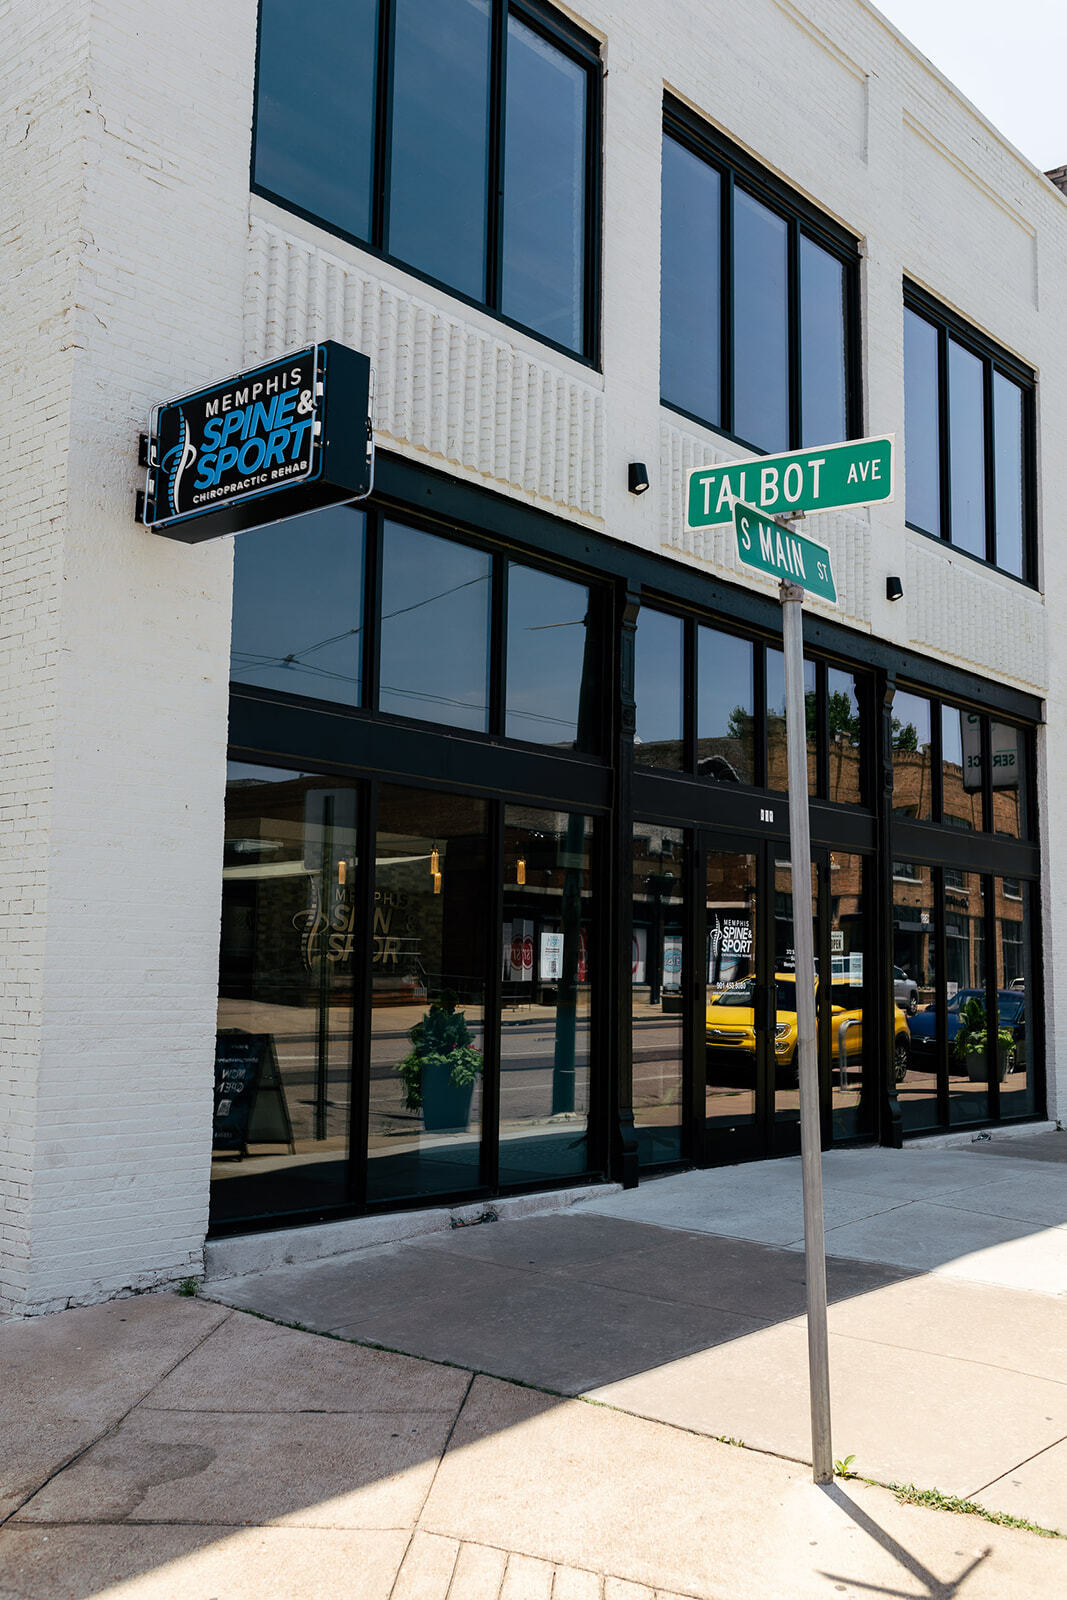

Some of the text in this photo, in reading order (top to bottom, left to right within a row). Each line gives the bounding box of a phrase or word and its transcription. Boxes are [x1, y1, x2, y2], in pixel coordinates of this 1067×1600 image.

[205, 367, 302, 418] MEMPHIS
[200, 387, 314, 453] SPINE &
[193, 418, 313, 490] SPORT
[192, 460, 308, 504] CHIROPRACTIC REHAB
[699, 458, 882, 515] TALBOT AVE
[740, 516, 829, 583] S MAIN ST
[721, 939, 753, 953] SPORT
[722, 926, 749, 940] SPINE
[723, 919, 750, 928] MEMPHIS
